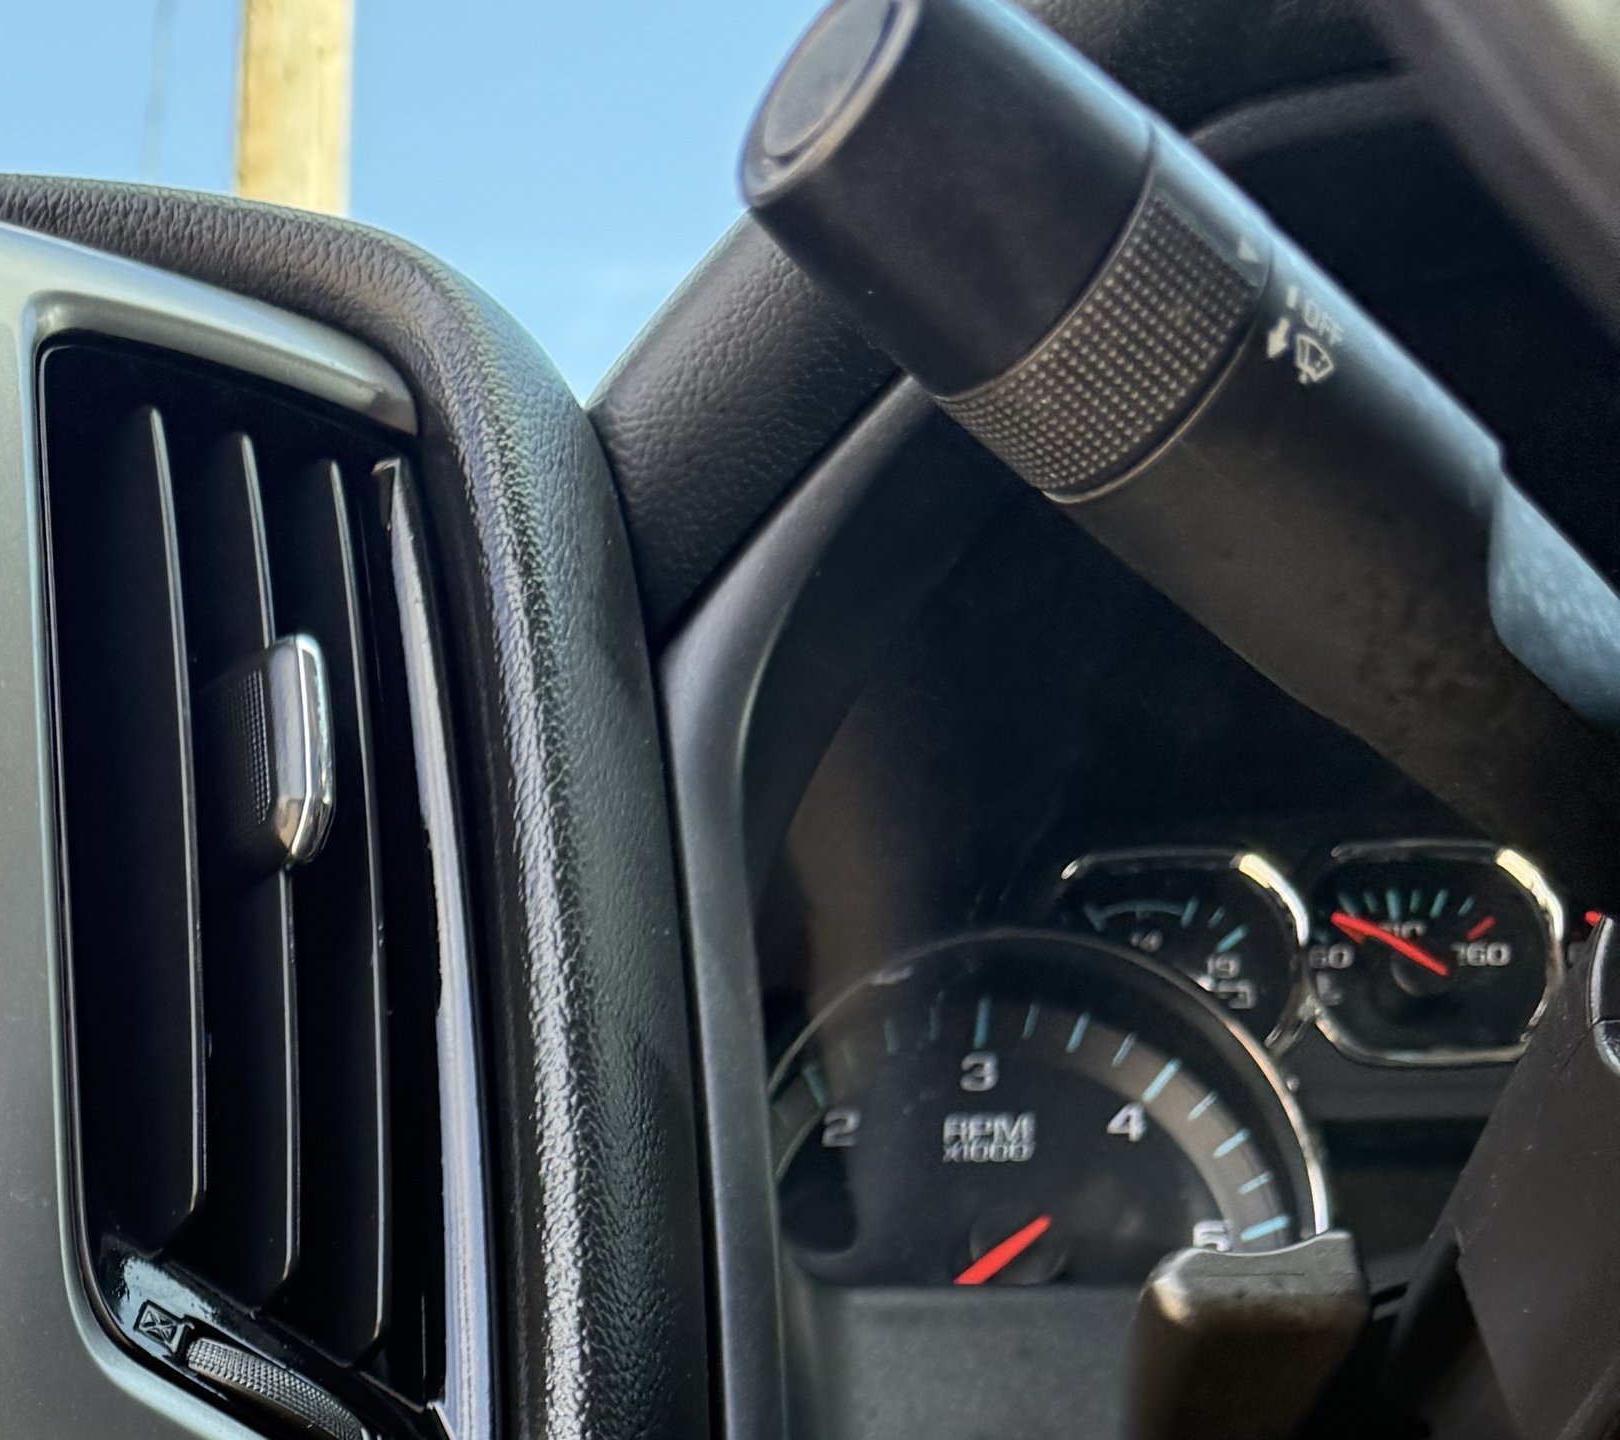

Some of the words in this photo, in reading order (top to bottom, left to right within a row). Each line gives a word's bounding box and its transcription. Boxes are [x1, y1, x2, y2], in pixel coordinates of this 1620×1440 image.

[1302, 299, 1343, 346] OFF
[960, 1051, 999, 1091] 3
[822, 1108, 861, 1147] 2
[942, 1111, 1036, 1142] RPM
[1106, 1102, 1146, 1142] 4
[1193, 1218, 1234, 1251] 5
